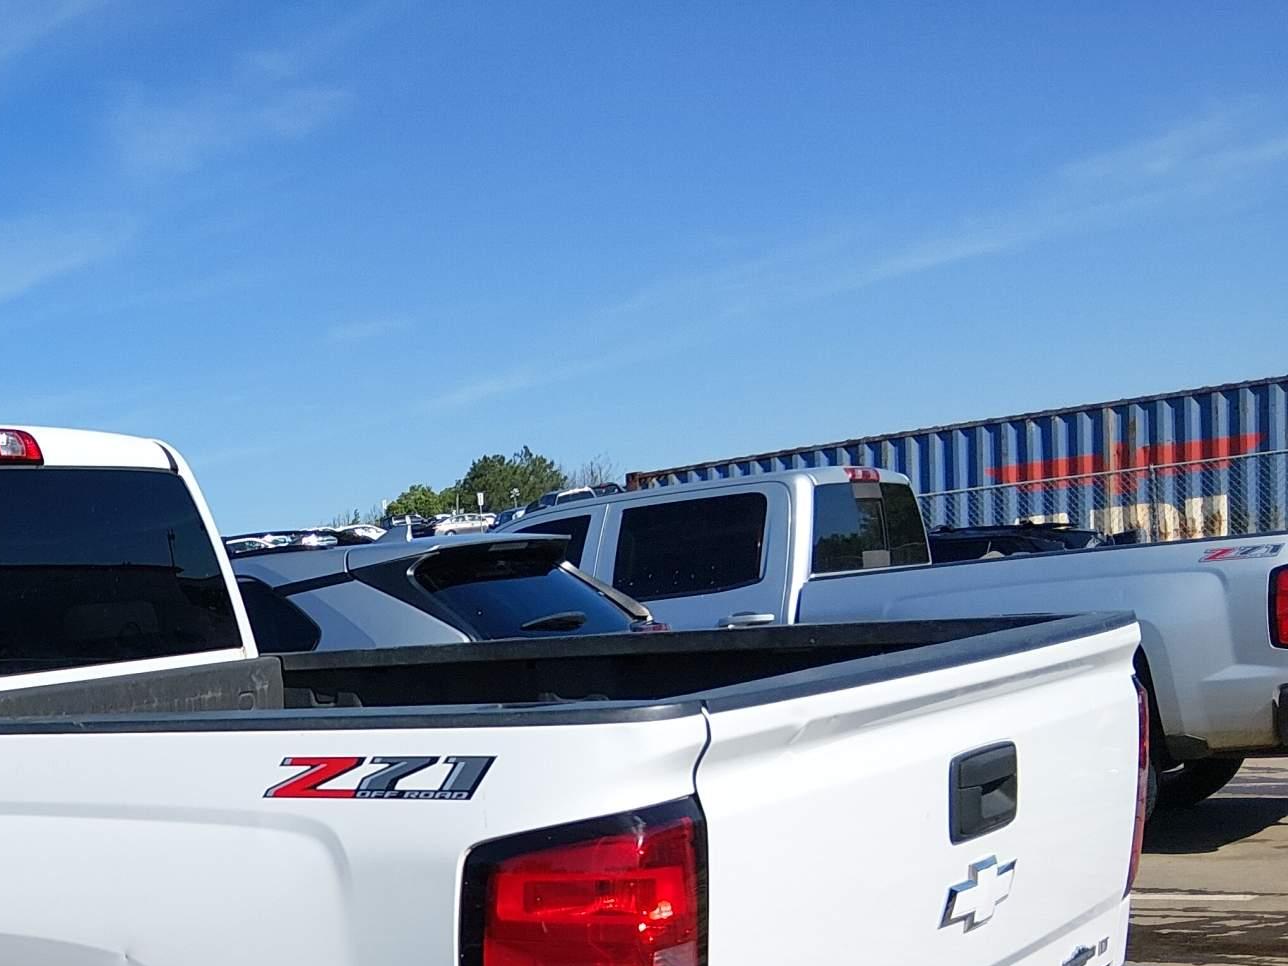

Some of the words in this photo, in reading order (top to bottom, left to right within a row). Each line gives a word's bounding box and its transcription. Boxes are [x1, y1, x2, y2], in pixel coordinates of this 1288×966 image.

[1198, 542, 1286, 563] Z71
[262, 755, 498, 800] Z71
[355, 790, 399, 799] OFF
[403, 790, 469, 799] ROAD
